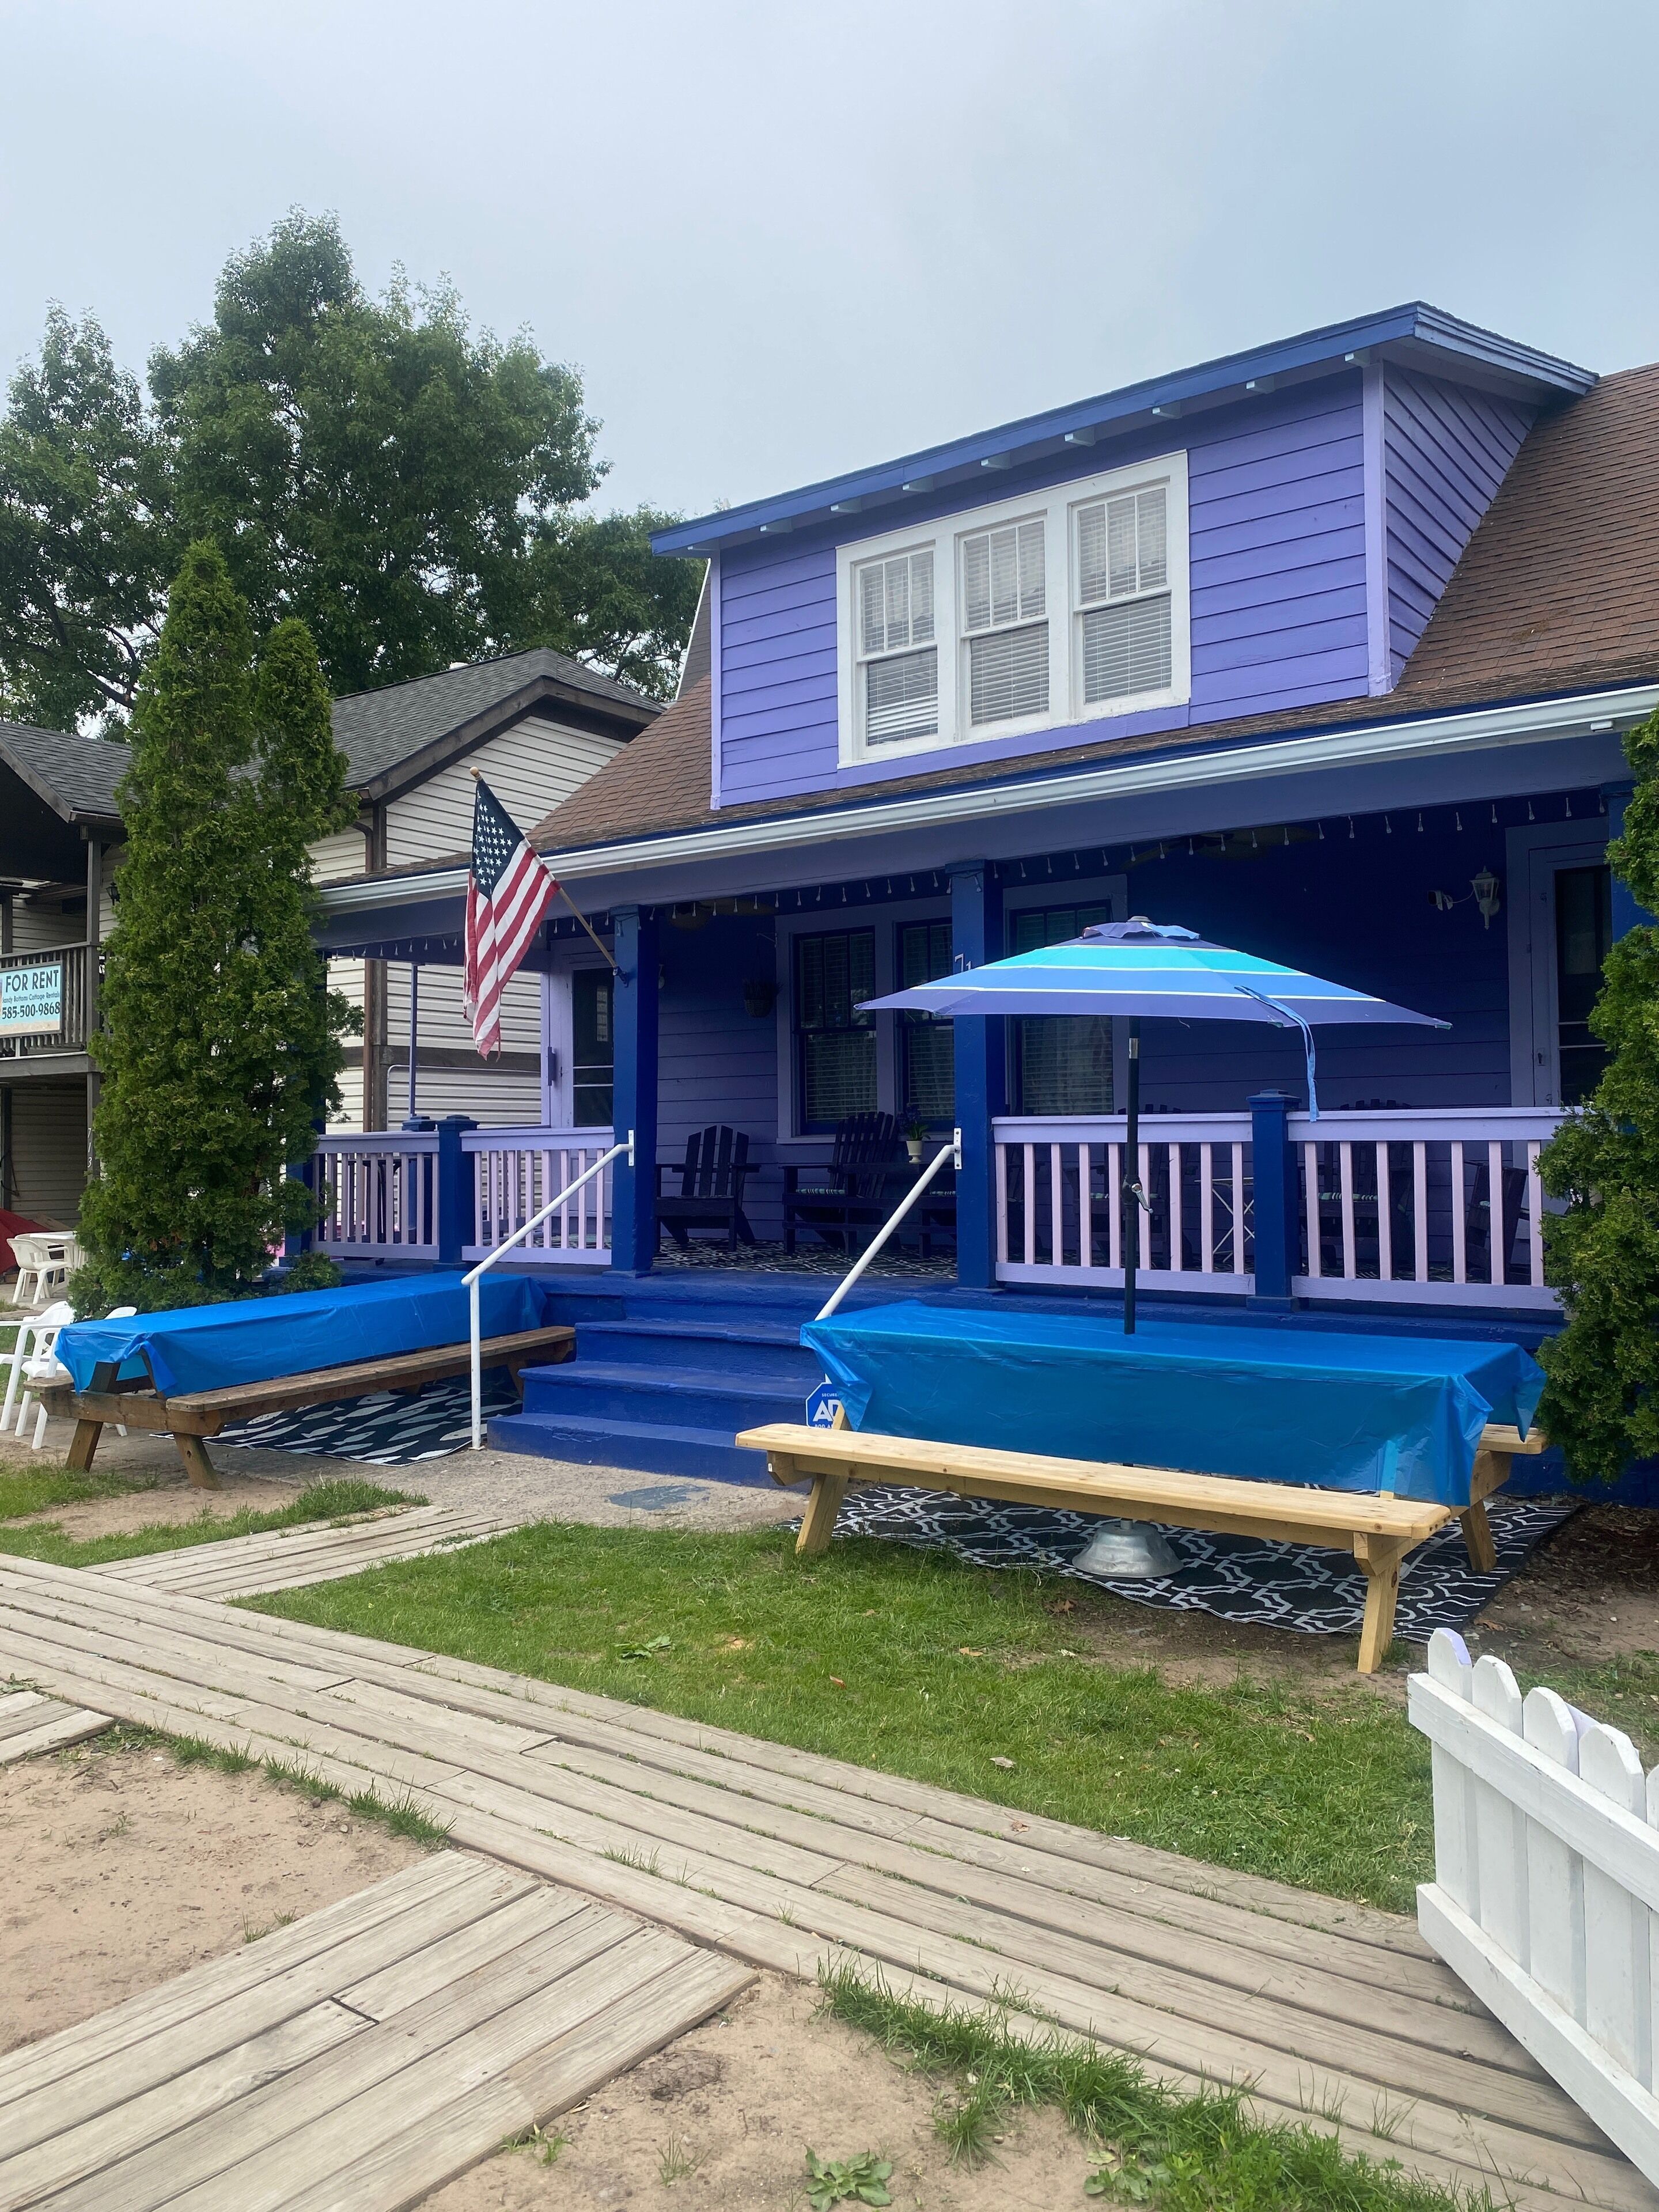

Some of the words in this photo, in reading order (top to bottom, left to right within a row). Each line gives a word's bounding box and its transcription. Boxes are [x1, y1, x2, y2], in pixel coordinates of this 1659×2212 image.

[6, 974, 28, 993] FOR
[32, 969, 59, 989] RENT
[2, 1002, 60, 1020] 585-500-9868
[812, 1399, 841, 1422] AD
